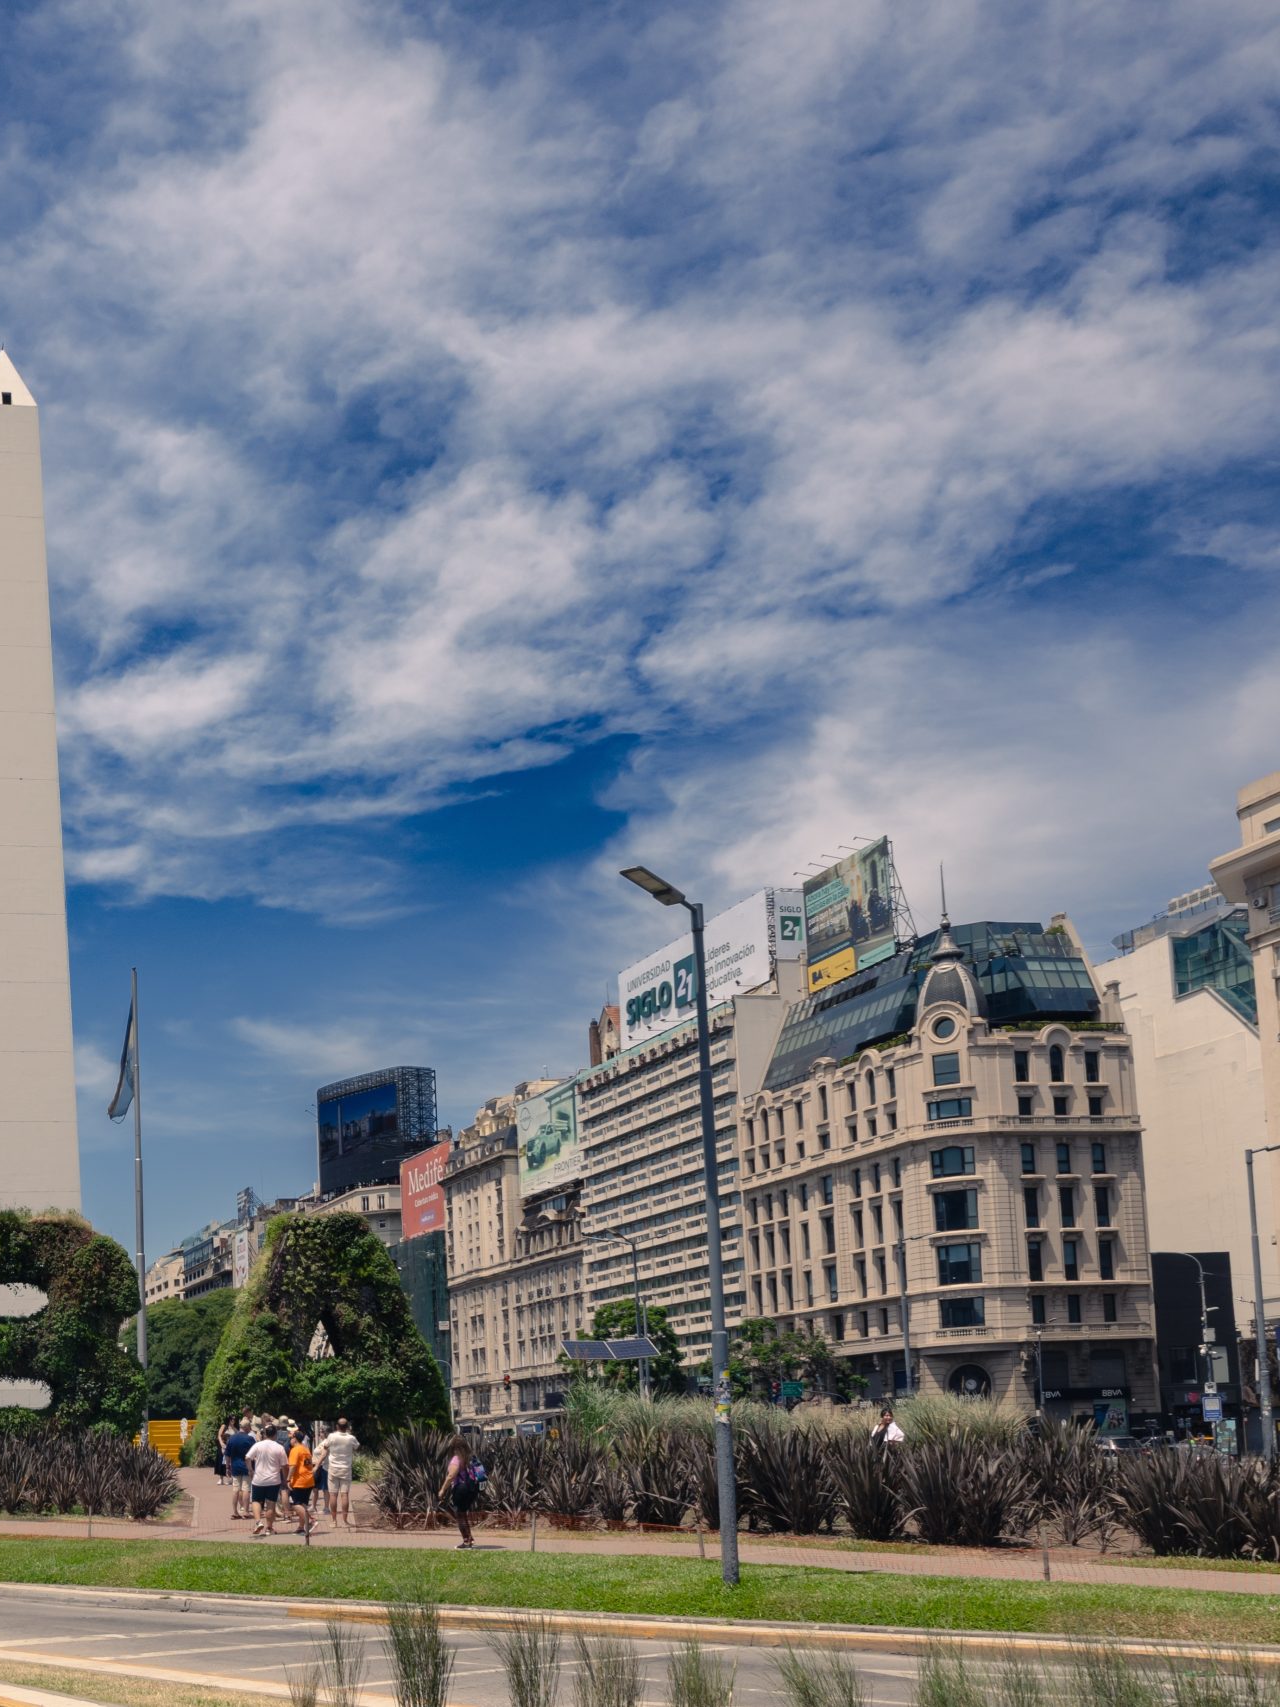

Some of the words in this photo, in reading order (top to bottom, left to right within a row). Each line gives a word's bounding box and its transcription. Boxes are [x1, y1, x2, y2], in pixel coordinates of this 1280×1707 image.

[783, 920, 800, 941] 21
[704, 942, 730, 963] íderes
[704, 966, 714, 978] en
[714, 944, 756, 973] innovación
[627, 960, 671, 993] UNIVERSIDAD
[626, 981, 673, 1026] SIGLO
[677, 968, 694, 1004] 21
[408, 1156, 444, 1196] Medifé
[1101, 1388, 1123, 1398] BBVA
